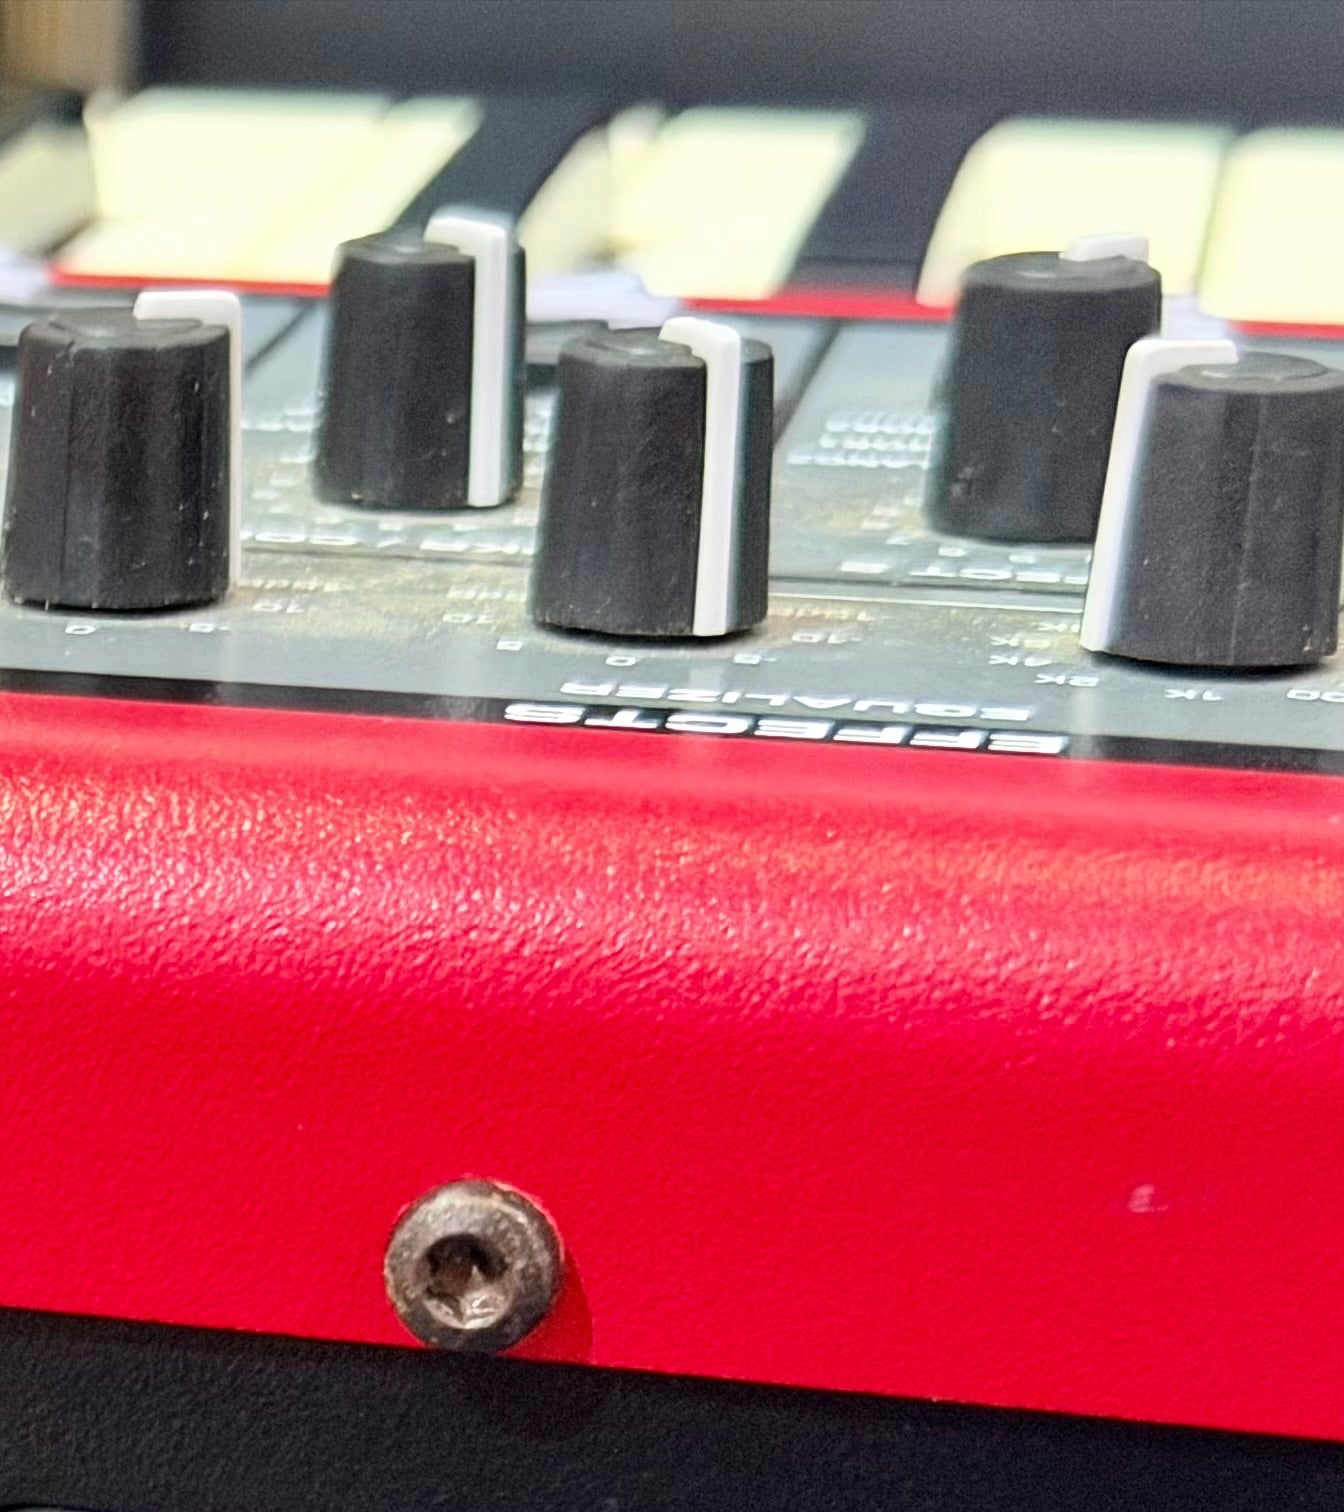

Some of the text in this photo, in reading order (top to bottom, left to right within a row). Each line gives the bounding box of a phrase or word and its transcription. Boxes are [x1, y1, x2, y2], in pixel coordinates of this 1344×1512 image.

[1033, 672, 1101, 688] 2K
[559, 681, 1034, 722] EQUALIZER
[1164, 687, 1225, 702] 1K
[503, 702, 1071, 756] EFFECTS
